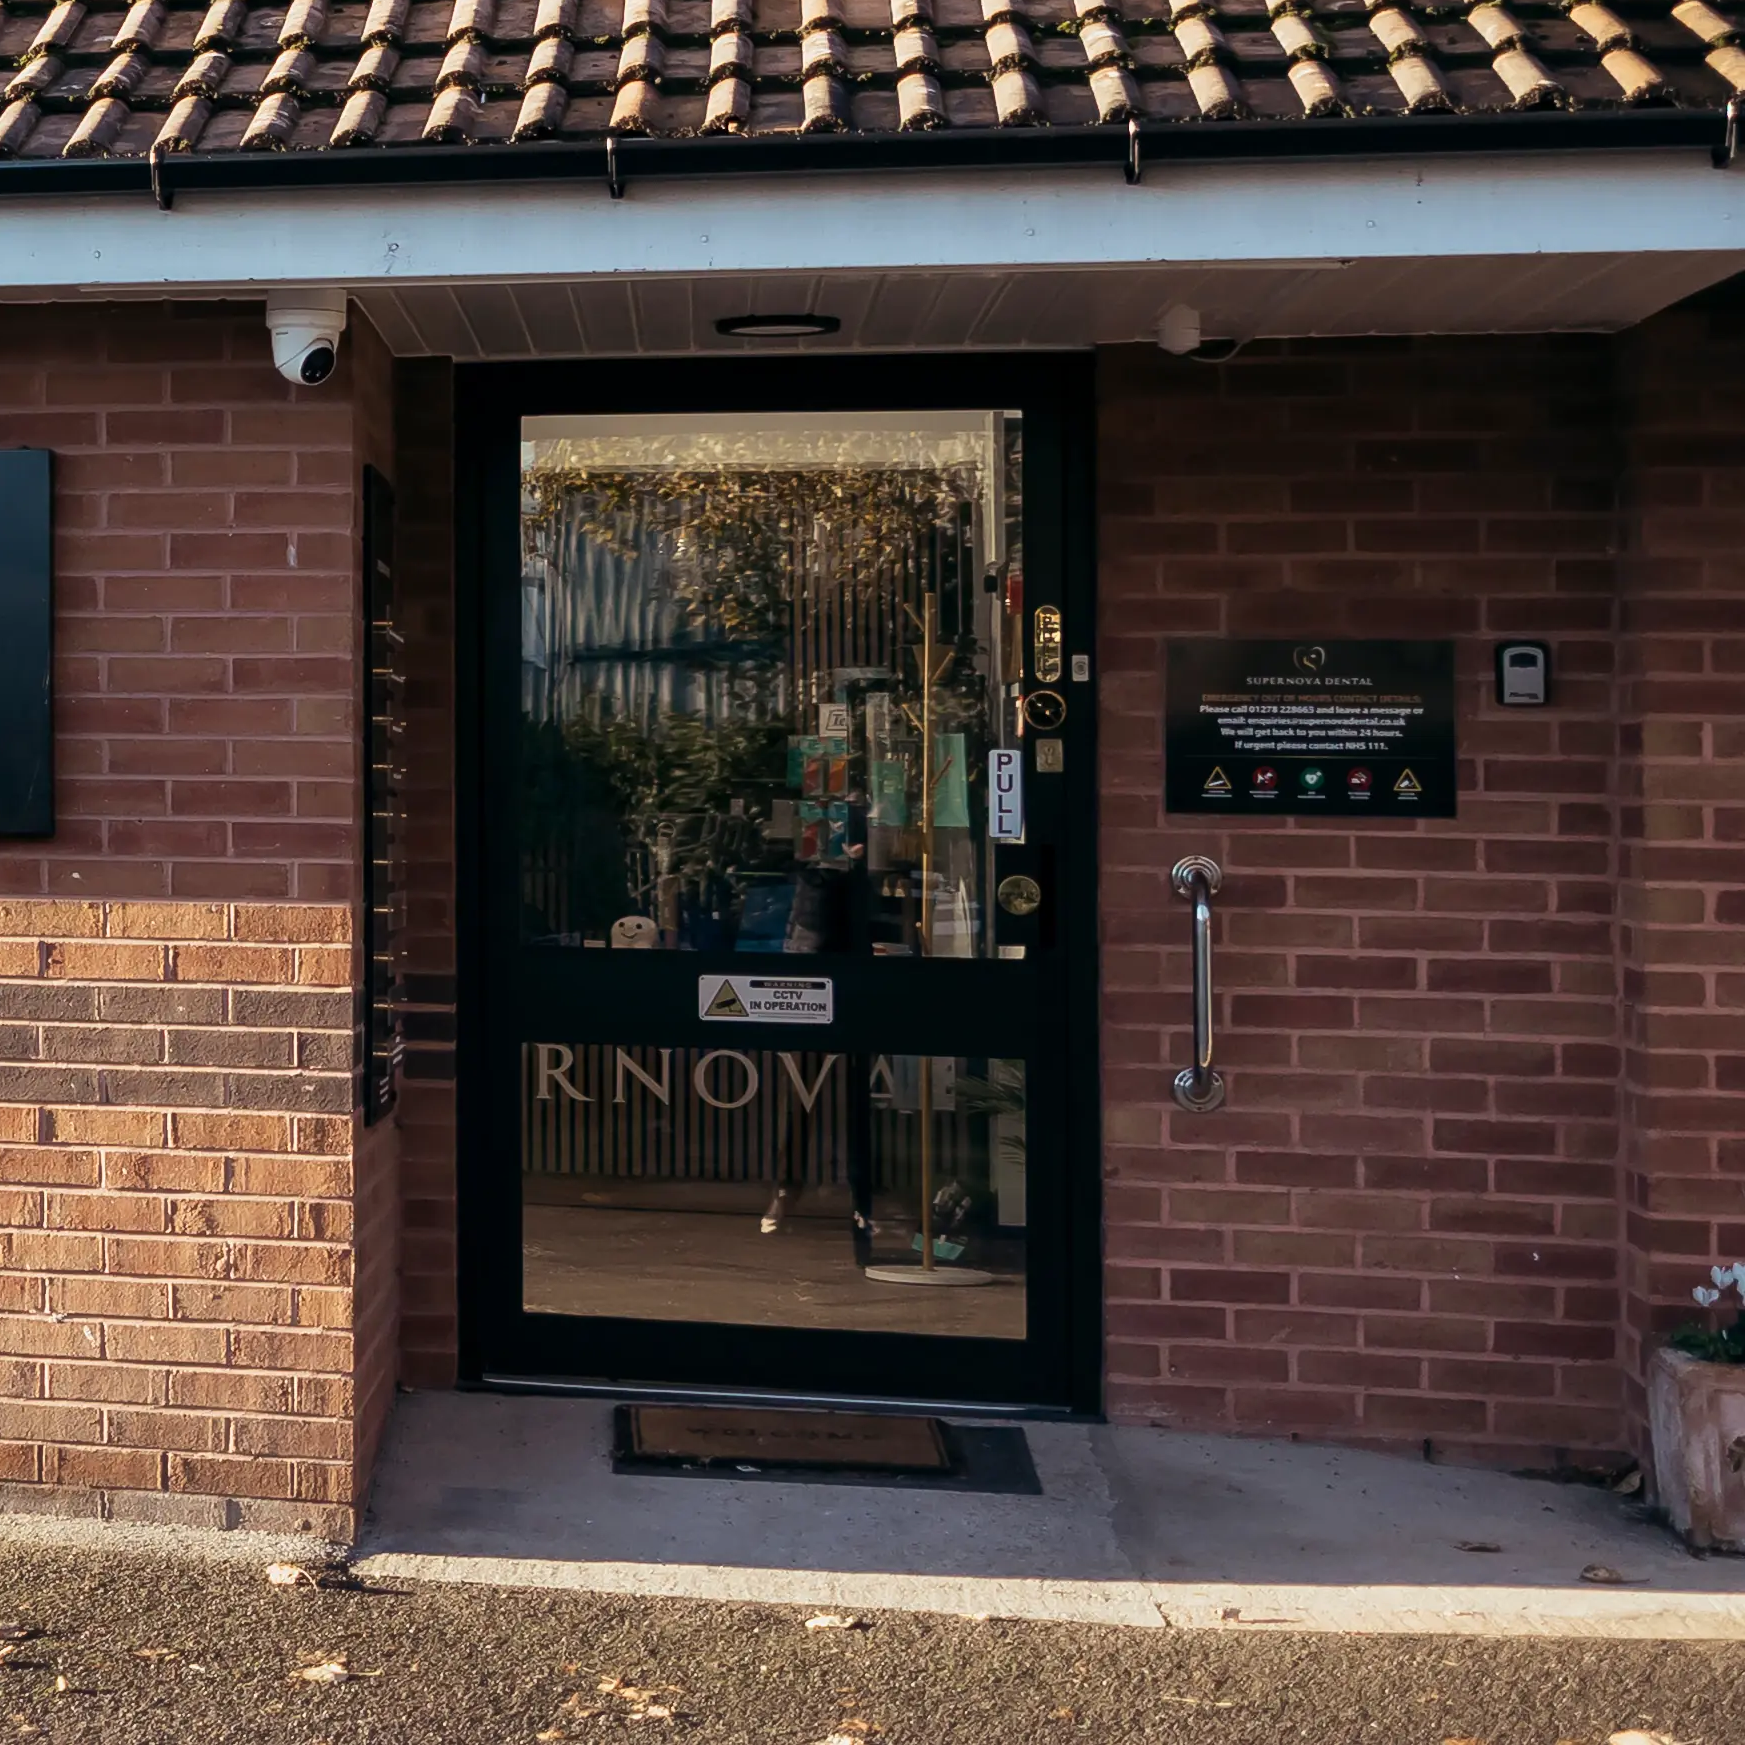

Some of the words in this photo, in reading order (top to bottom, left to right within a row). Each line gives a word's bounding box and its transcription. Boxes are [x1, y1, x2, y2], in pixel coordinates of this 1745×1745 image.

[1246, 676, 1321, 686] SUPERNOVA
[1325, 677, 1374, 686] DENTAL
[1199, 705, 1229, 713] Please
[1231, 705, 1247, 713] call
[1249, 705, 1278, 713] 01278
[1316, 706, 1334, 714] and
[1335, 706, 1361, 714] leave
[1369, 708, 1411, 716] message
[1255, 728, 1271, 738] get
[1308, 729, 1326, 738] you
[1243, 741, 1275, 751] urgent
[1276, 741, 1307, 751] please
[1308, 741, 1343, 750] contact
[1345, 742, 1366, 750] NHS
[996, 753, 1014, 834] PULL
[773, 990, 803, 1000] CCTV
[750, 1001, 762, 1010] IN
[764, 1001, 827, 1012] OPERATION
